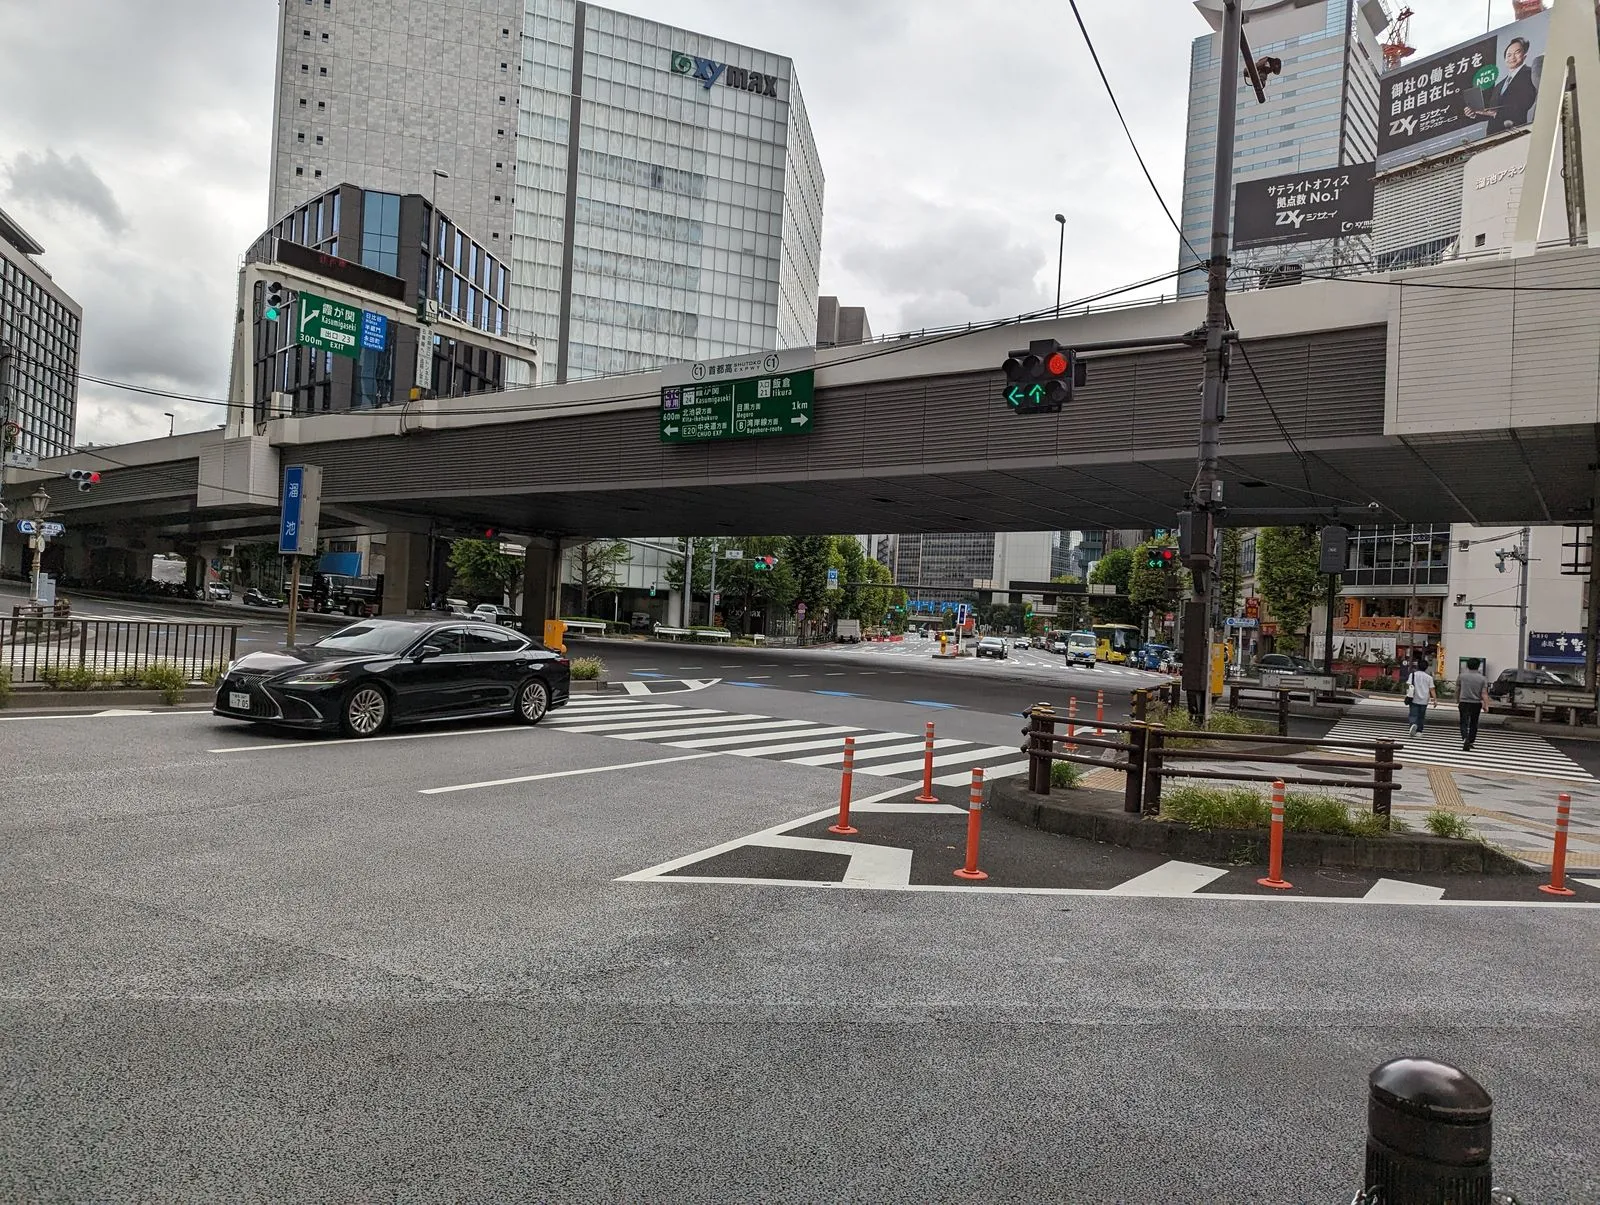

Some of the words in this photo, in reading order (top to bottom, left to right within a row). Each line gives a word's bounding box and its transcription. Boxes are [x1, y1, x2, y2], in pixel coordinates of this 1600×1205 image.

[1391, 53, 1483, 99] 御社の働き方を
[1476, 73, 1495, 87] No.1
[1391, 82, 1460, 116] 自由自在に。
[1388, 115, 1419, 136] ZXY
[1268, 175, 1350, 197] サテライトオフィス
[1277, 194, 1307, 208] 拠点数
[1275, 209, 1305, 229] ZXY
[323, 303, 355, 322] 霞が関
[321, 315, 356, 331] Kasumigaseki
[300, 333, 322, 346] 300m
[325, 330, 338, 339] 出口
[342, 334, 351, 343] 23
[330, 341, 345, 350] EXIT
[766, 358, 775, 368] C1
[694, 366, 703, 377] C1
[709, 364, 732, 376] 首都高
[773, 377, 791, 388] 飯倉
[696, 394, 731, 404] Kasumigaseki
[773, 389, 792, 397] Iikura
[737, 403, 761, 411] 目黒方面
[792, 401, 808, 410] 1km
[697, 422, 727, 430] 中央道方面
